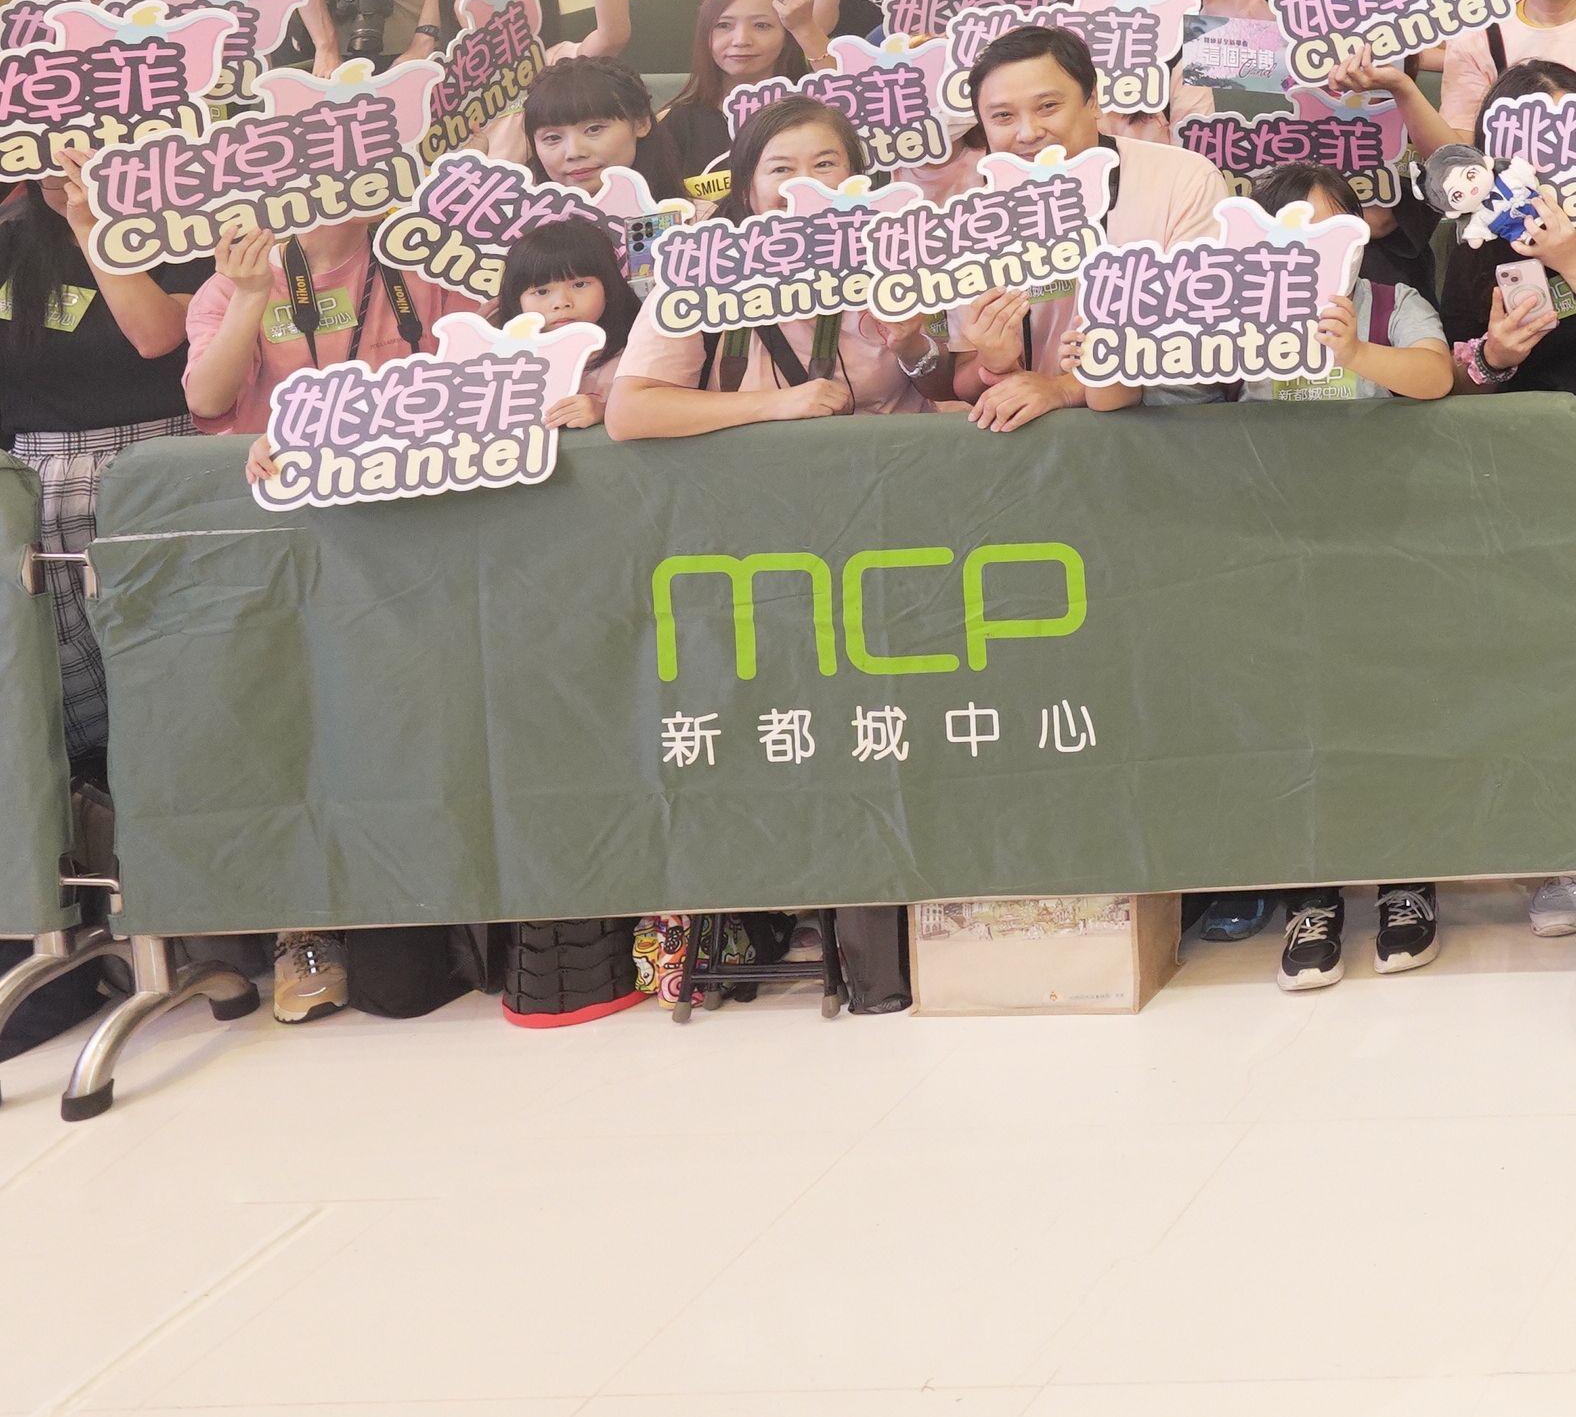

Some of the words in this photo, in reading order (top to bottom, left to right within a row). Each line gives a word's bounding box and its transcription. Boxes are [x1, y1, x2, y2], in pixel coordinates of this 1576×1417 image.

[421, 45, 546, 164] Chantel
[100, 100, 394, 215] 姚焯菲
[1184, 123, 1382, 170] 姚焯菲
[107, 158, 414, 264] Chantel
[694, 176, 731, 196] SMILE
[874, 181, 1081, 271] 姚焯菲
[295, 275, 310, 304] Nikon
[393, 285, 411, 313] Nikon
[660, 271, 869, 328] Chante
[876, 228, 1099, 314] Chantel
[1089, 248, 1320, 327] 姚焯菲
[1080, 321, 1323, 376] Chantel
[280, 358, 544, 448] 姚焯菲
[269, 424, 544, 500] Chantel
[661, 700, 1097, 767] 新都城中心
